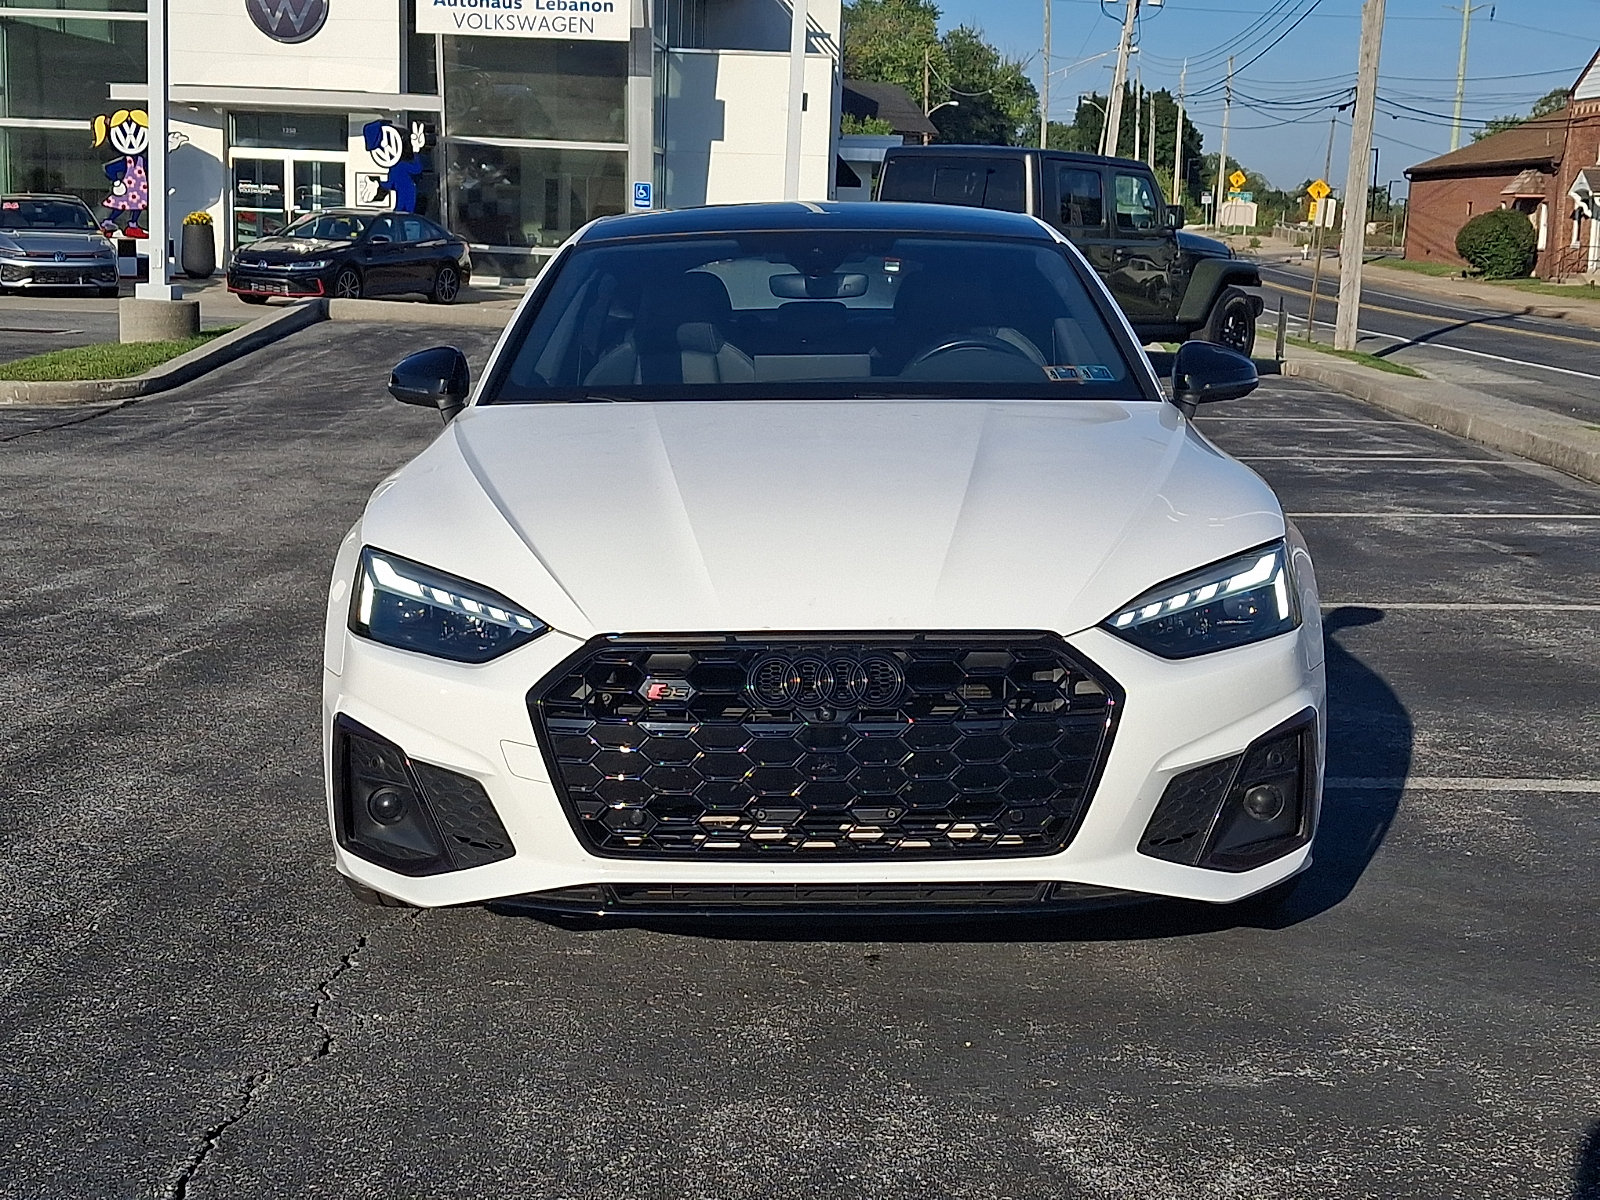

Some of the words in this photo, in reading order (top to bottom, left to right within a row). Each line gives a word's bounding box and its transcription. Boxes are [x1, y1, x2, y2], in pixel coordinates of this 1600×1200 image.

[433, 0, 522, 10] Autohaus
[535, 0, 614, 12] Lebanon
[453, 12, 594, 33] VOLKSWAGEN
